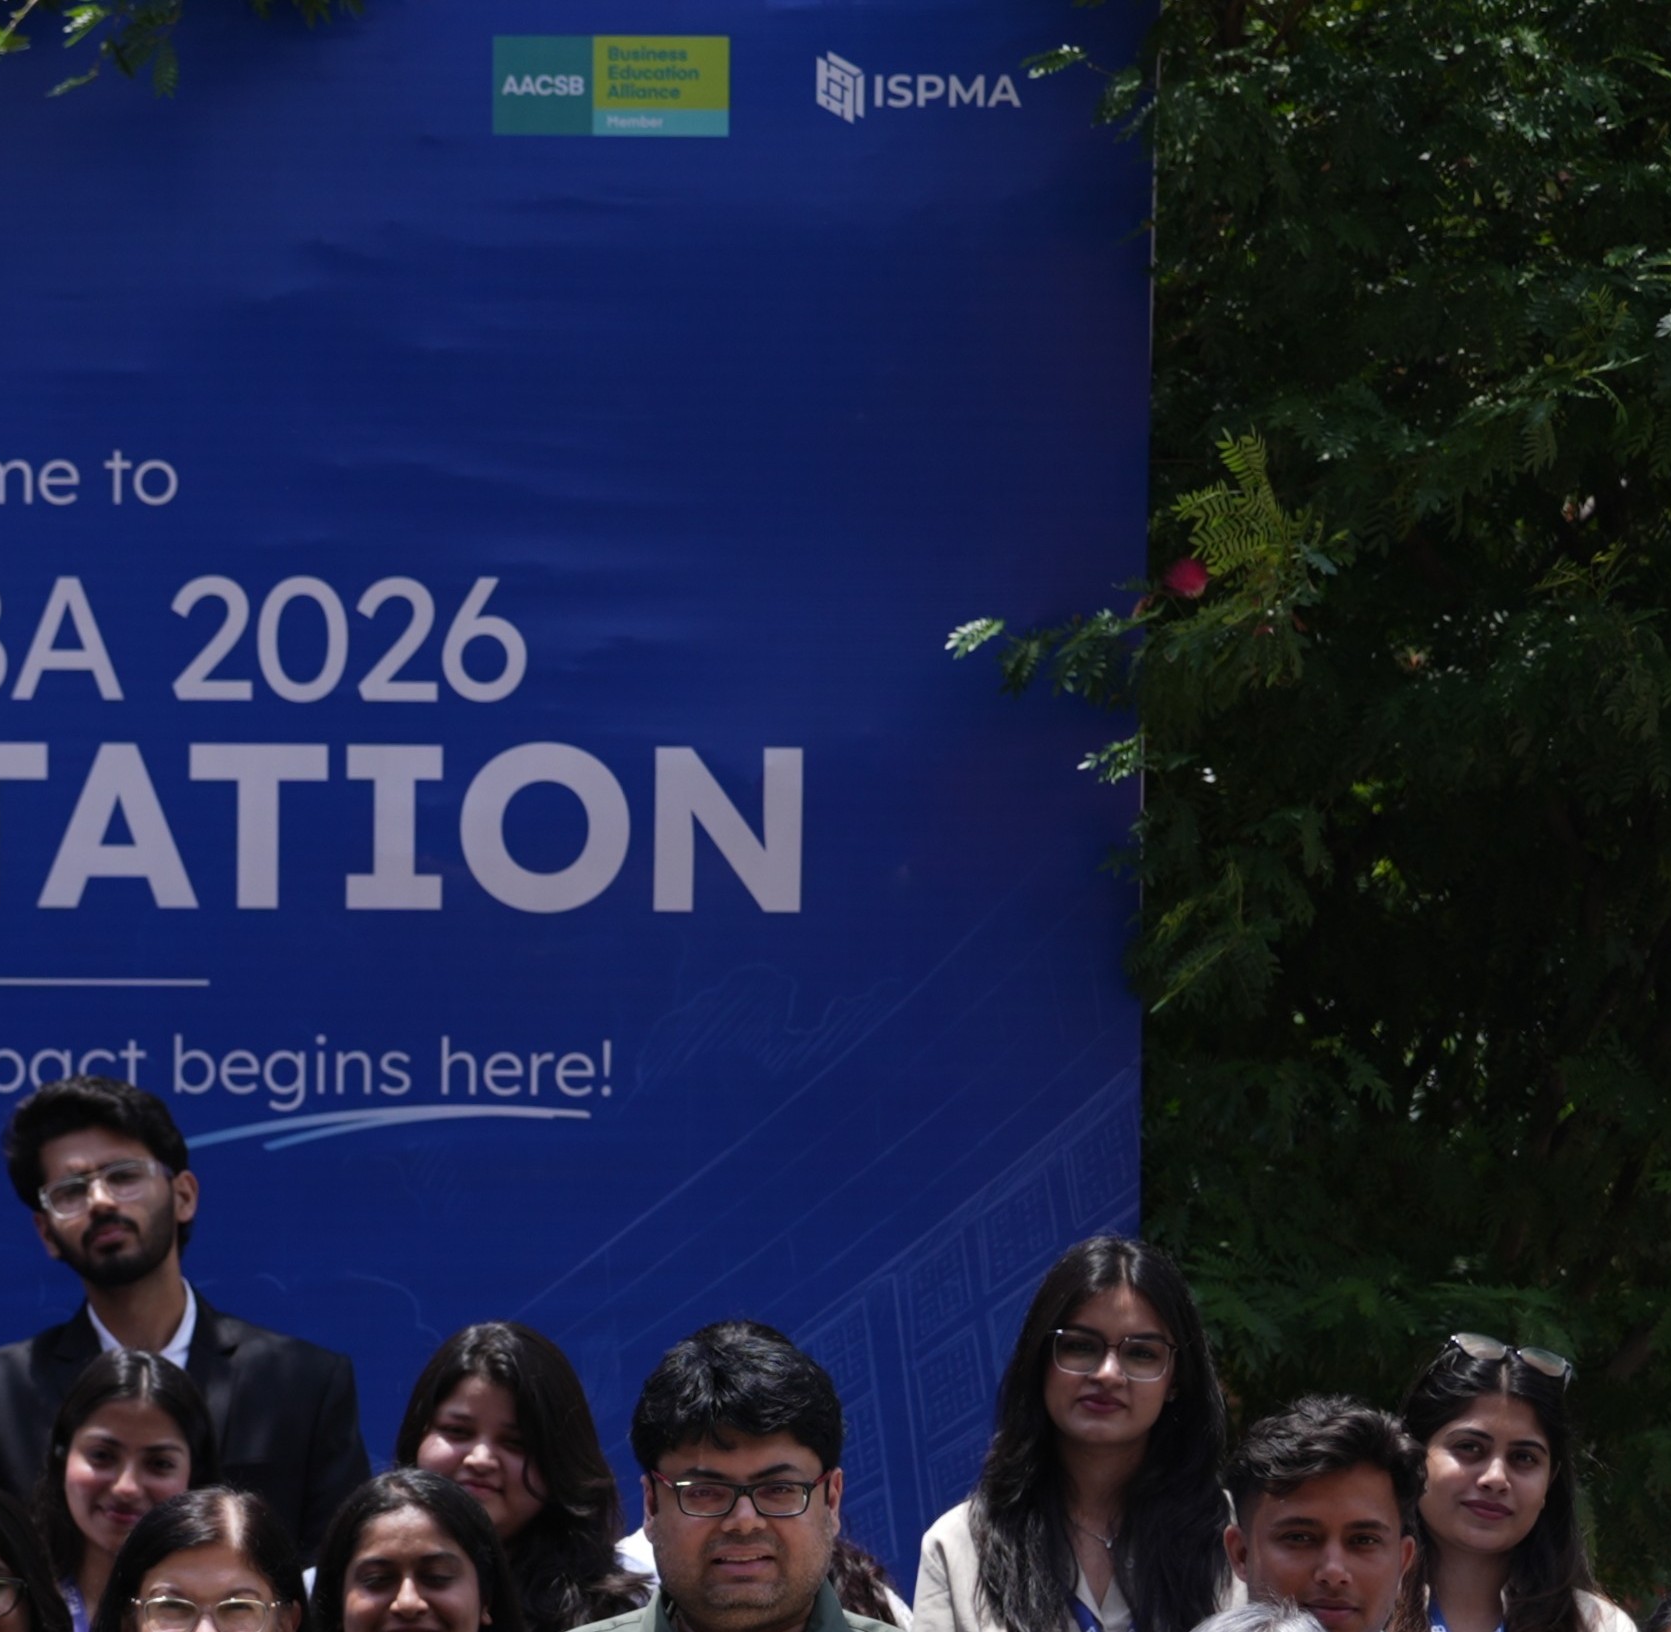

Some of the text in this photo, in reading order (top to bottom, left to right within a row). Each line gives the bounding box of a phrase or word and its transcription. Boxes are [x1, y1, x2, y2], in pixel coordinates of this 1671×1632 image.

[608, 46, 688, 62] Business
[608, 66, 699, 81] Education
[502, 74, 585, 96] AACSB
[608, 85, 681, 99] Alliance
[874, 74, 1022, 108] ISPMA
[606, 116, 663, 128] Member
[104, 449, 178, 505] to
[171, 575, 527, 703] 2026
[173, 1033, 412, 1111] begins
[440, 1035, 614, 1097] here!
